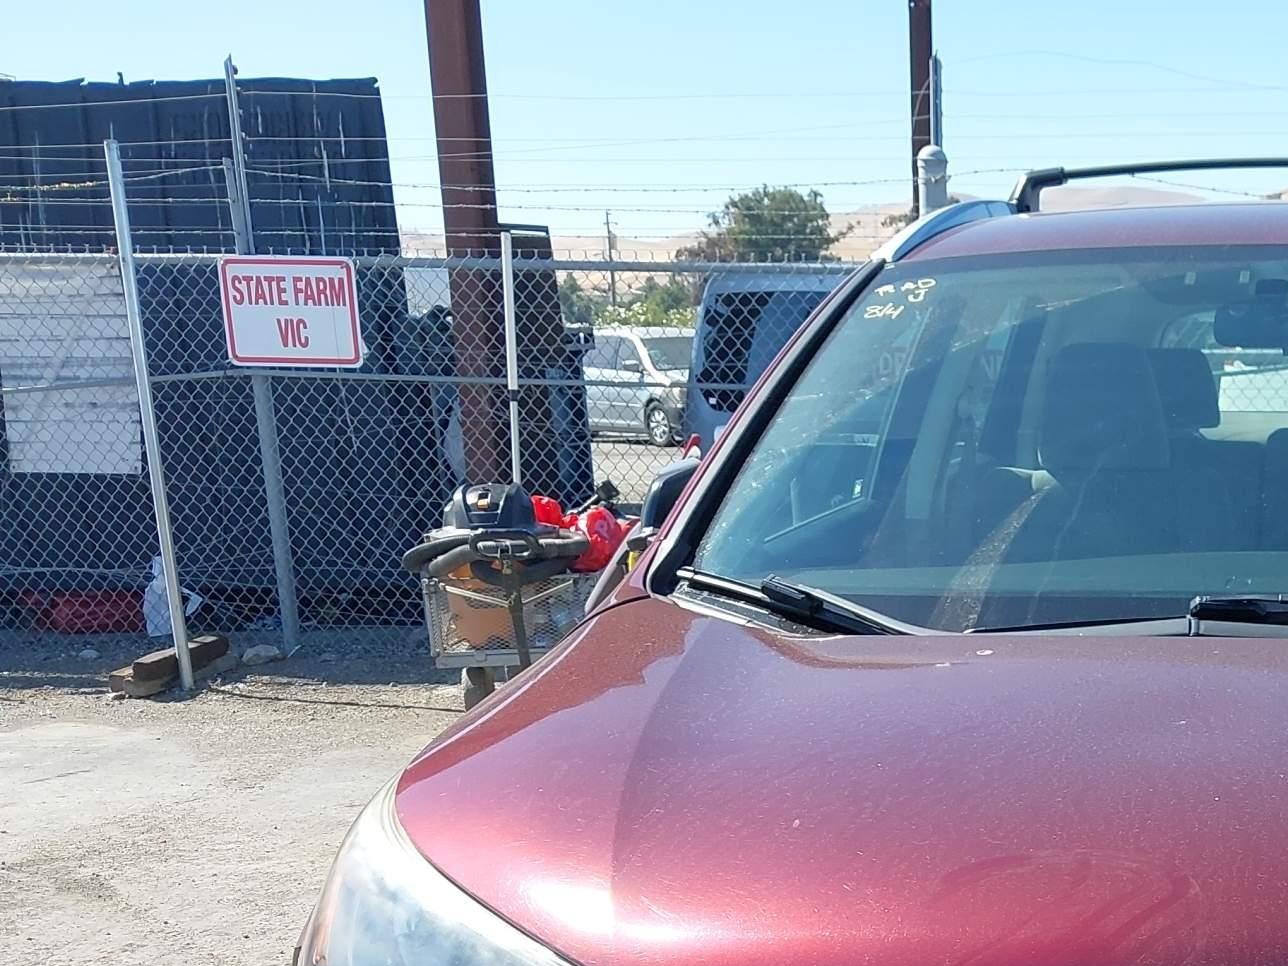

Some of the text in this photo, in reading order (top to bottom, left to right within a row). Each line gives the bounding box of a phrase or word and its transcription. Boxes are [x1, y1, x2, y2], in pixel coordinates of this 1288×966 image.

[231, 275, 347, 307] STATE FARM
[276, 318, 309, 348] VIC
